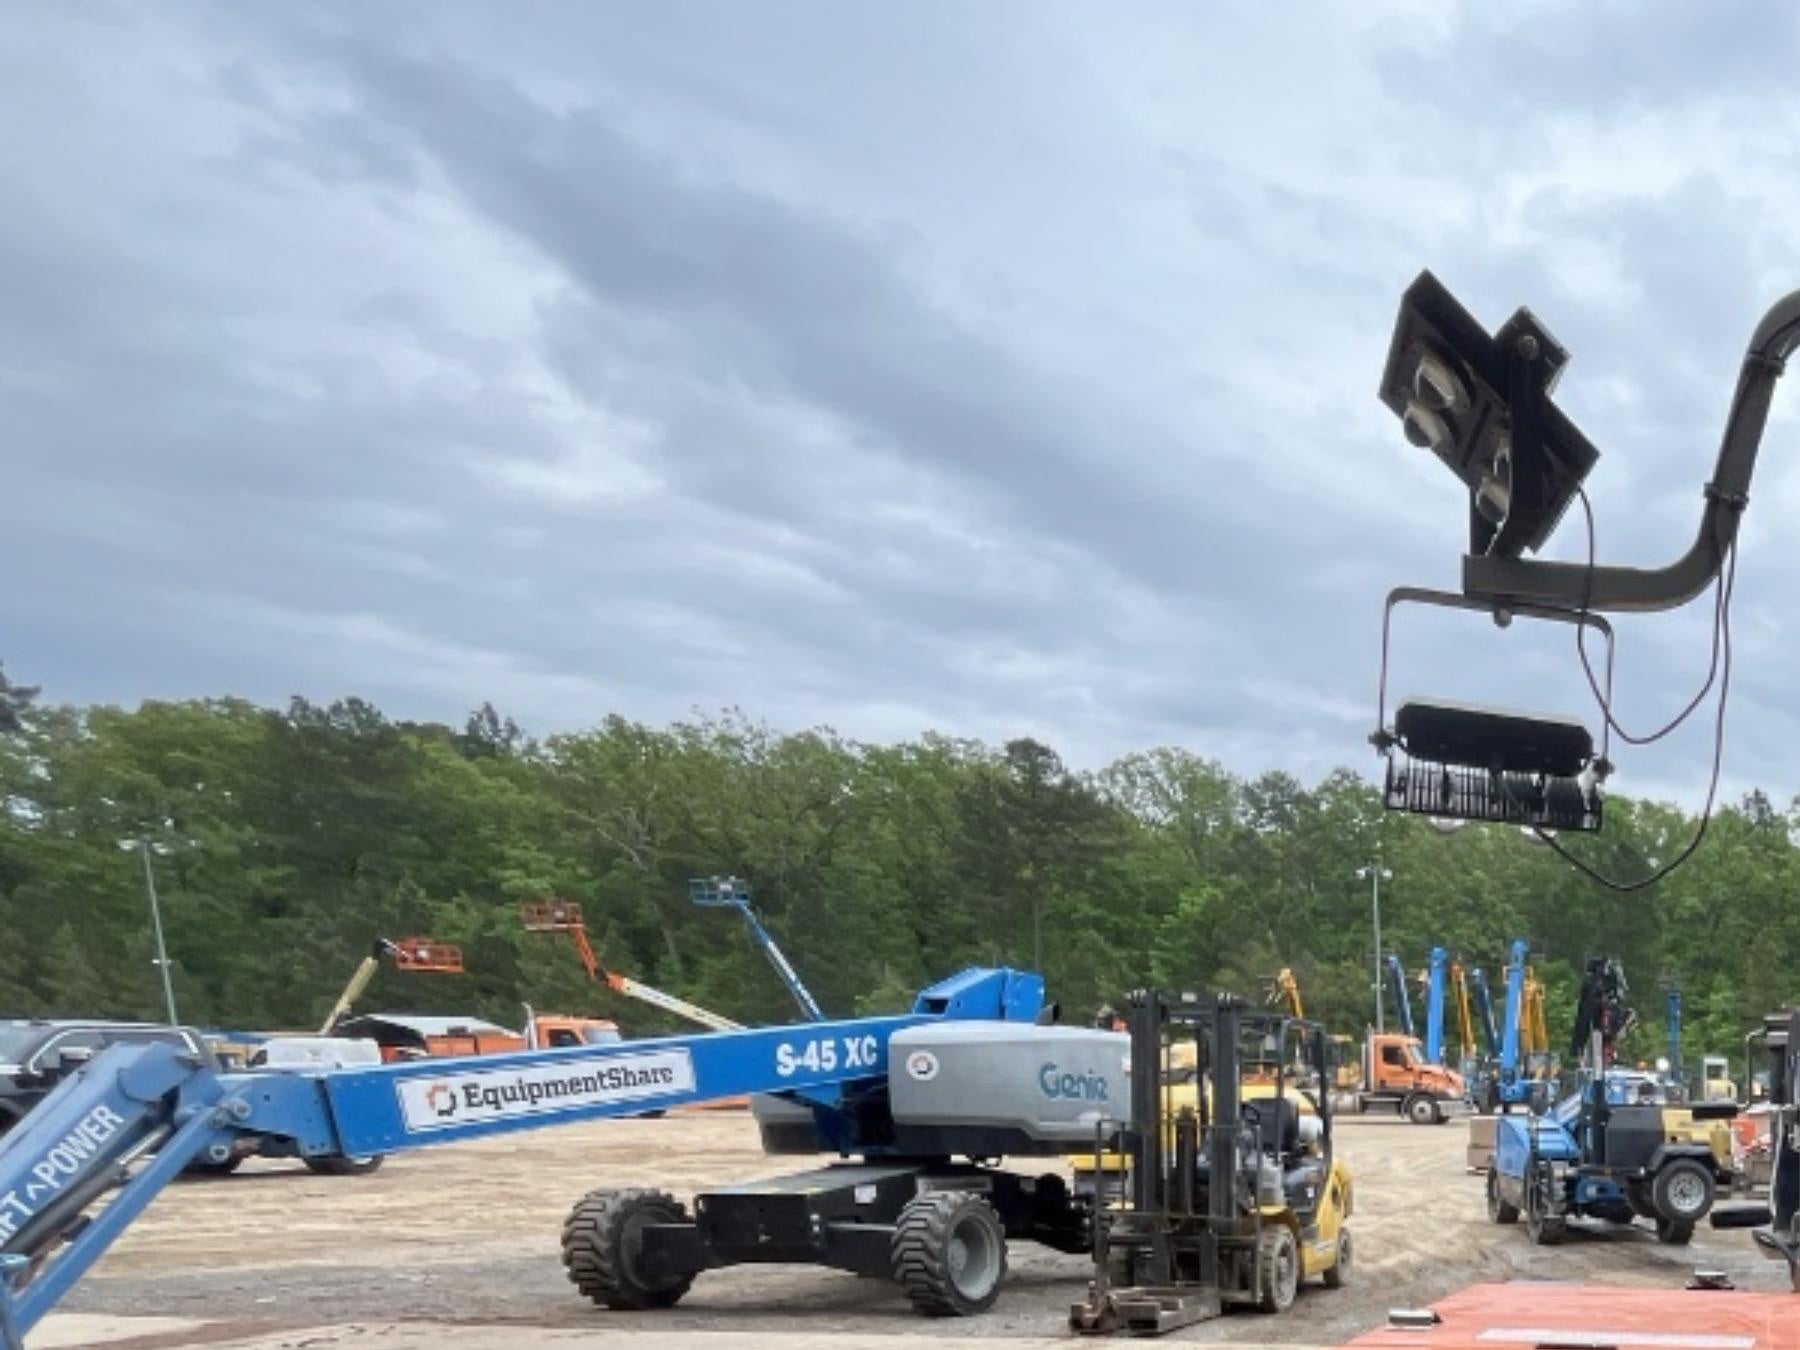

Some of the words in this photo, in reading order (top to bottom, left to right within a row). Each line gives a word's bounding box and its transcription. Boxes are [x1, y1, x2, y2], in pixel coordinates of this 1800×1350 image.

[776, 1039, 836, 1076] S-45
[843, 1033, 877, 1069] XC
[461, 1065, 674, 1110] EquipmentShare
[1039, 1061, 1108, 1101] Genie
[32, 1105, 125, 1189] POWER
